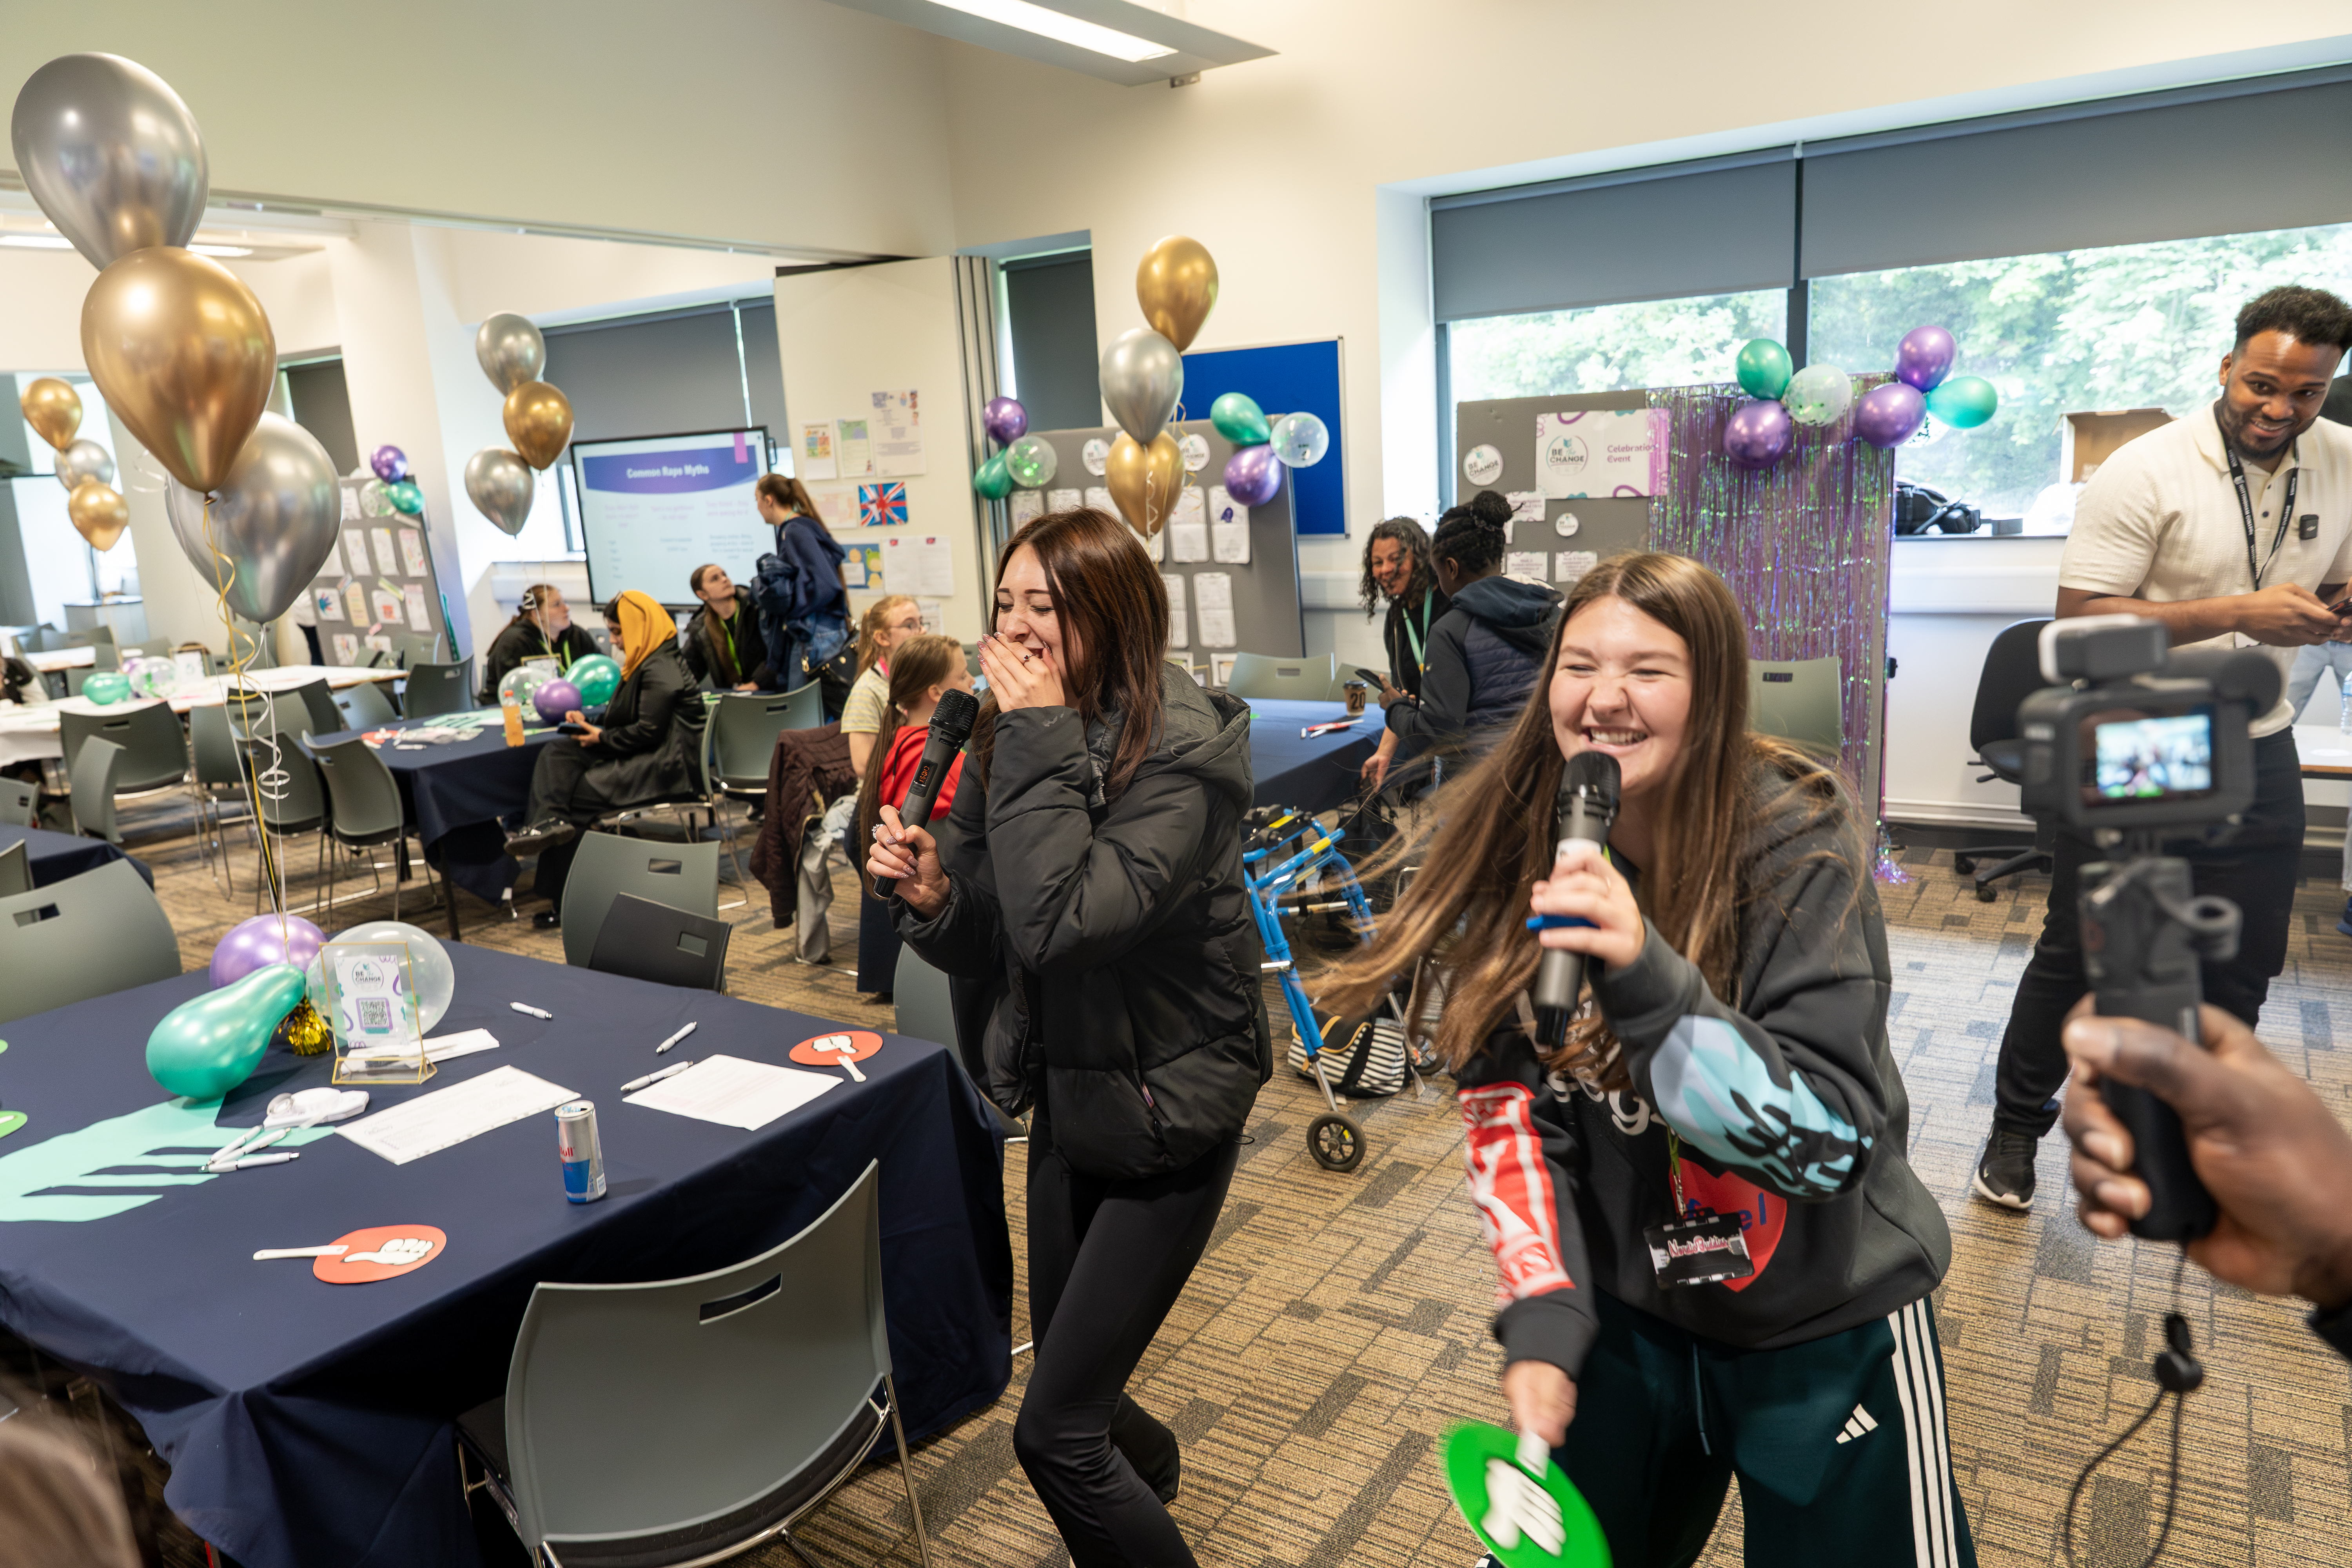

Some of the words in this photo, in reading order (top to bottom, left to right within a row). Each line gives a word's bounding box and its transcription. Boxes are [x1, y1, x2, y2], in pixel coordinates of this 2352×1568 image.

[1607, 455, 1631, 463] Event
[627, 468, 661, 479] Common
[684, 464, 710, 476] Myths
[1350, 691, 1367, 710] 20
